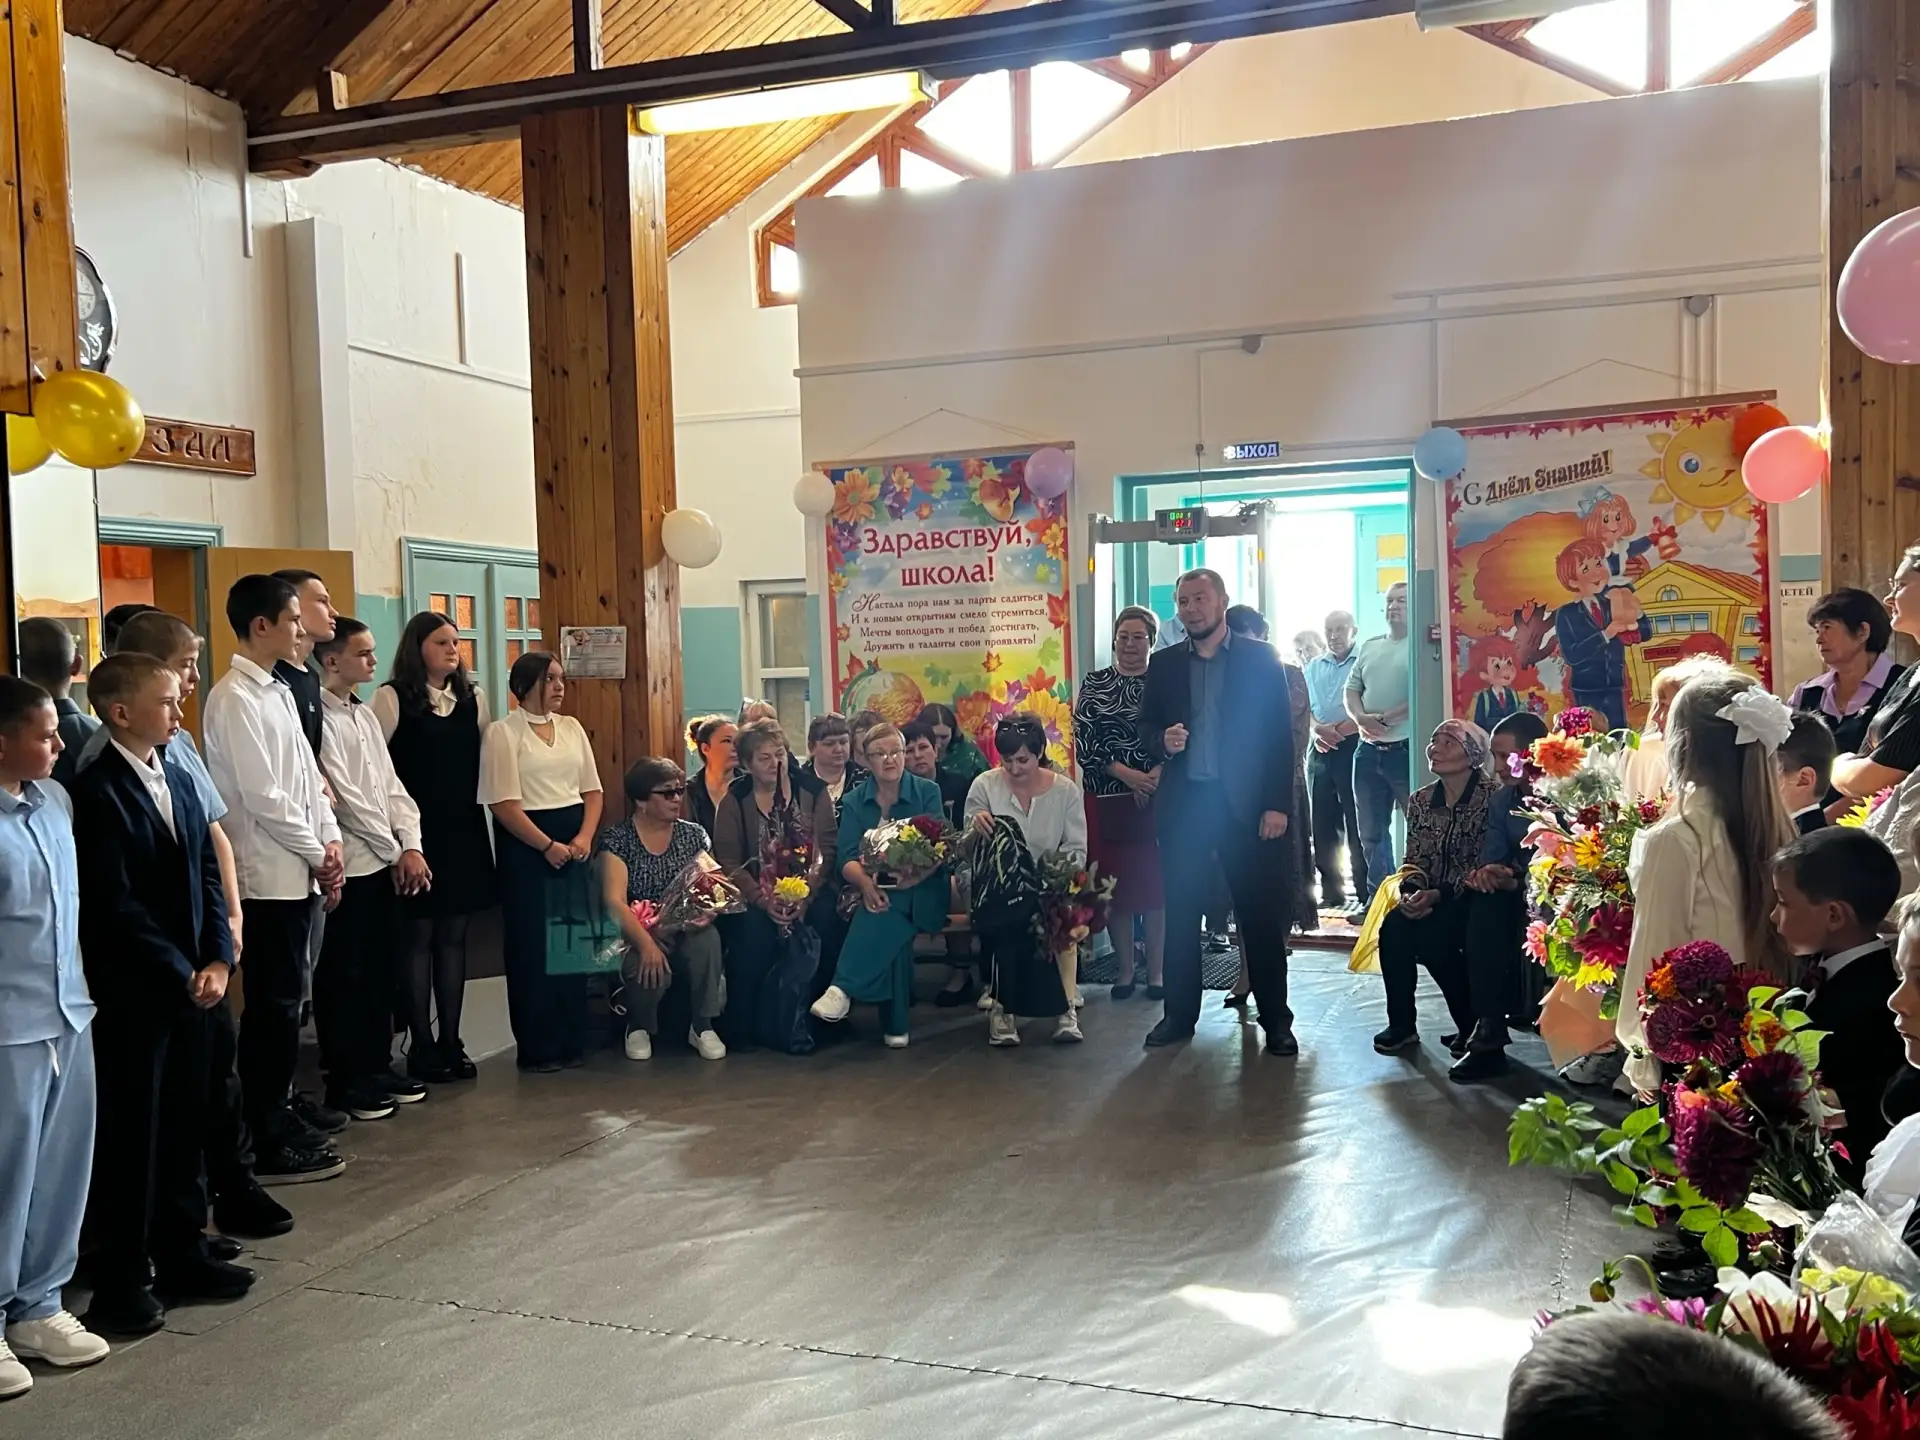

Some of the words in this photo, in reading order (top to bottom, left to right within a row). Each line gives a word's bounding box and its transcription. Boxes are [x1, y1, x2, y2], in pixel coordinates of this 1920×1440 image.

[152, 426, 232, 463] ЗАЛ
[1224, 443, 1278, 460] ВЫХОД
[1463, 482, 1482, 506] С
[1485, 474, 1532, 505] Днём
[1534, 449, 1613, 490] Знаний!
[863, 519, 1033, 559] Здравствуй,
[901, 556, 995, 587] школа!
[852, 593, 904, 612] Настала
[907, 599, 929, 609] пора
[932, 598, 950, 607] нам
[954, 598, 964, 606] за
[968, 596, 997, 606] парты
[1000, 594, 1044, 604] садиться
[851, 613, 860, 624] И
[873, 615, 903, 623] новым
[906, 612, 956, 623] открытиям
[960, 611, 987, 619] смело
[991, 608, 1048, 620] стремиться,
[860, 626, 892, 637] Мечты
[895, 626, 945, 637] воплощать
[948, 626, 954, 634] и
[958, 623, 986, 634] побед
[989, 622, 1040, 633] достигать,
[863, 640, 905, 652] Дружить
[918, 640, 956, 649] таланты
[959, 639, 981, 648] свои
[985, 633, 1036, 649] проявлять!
